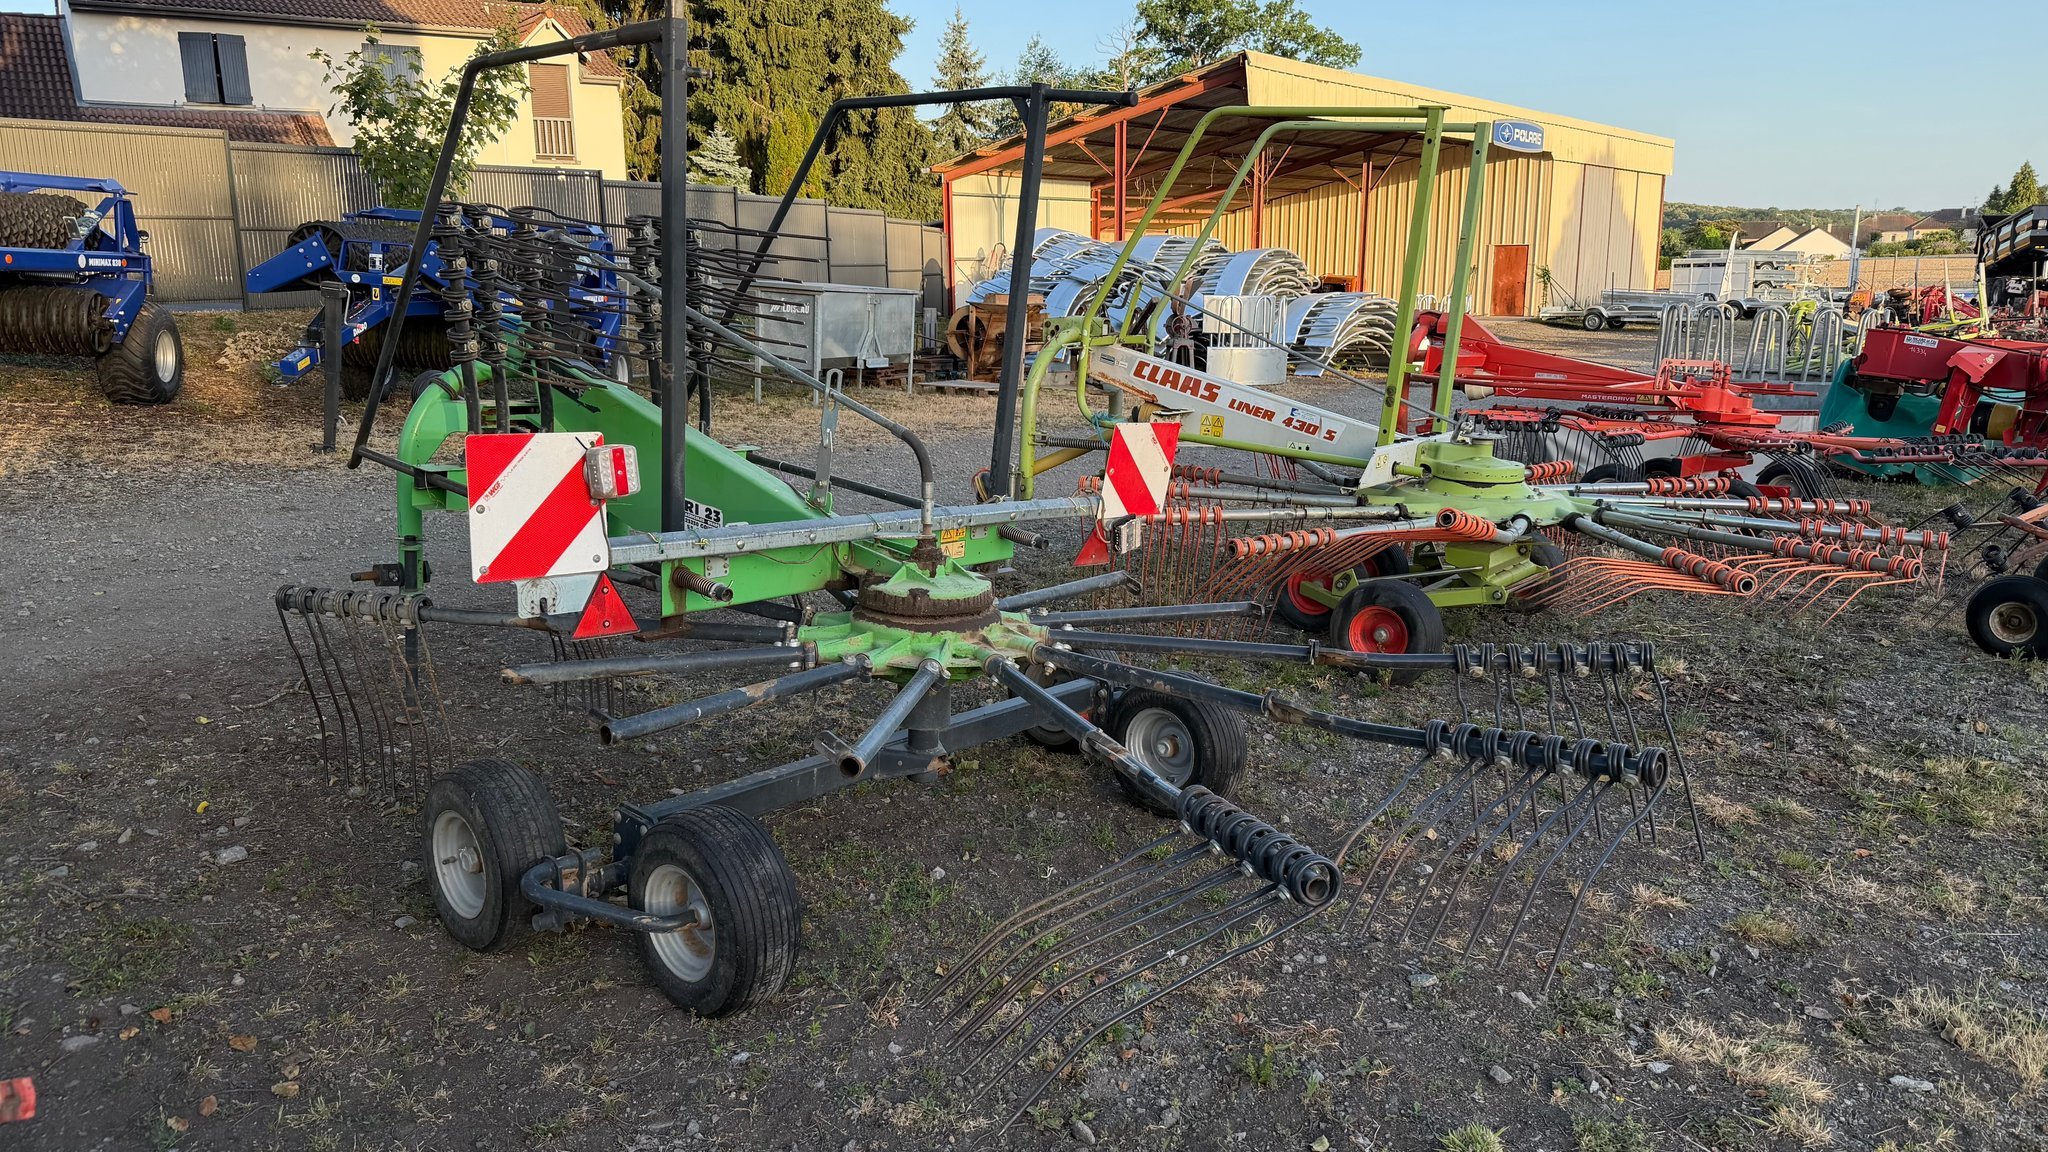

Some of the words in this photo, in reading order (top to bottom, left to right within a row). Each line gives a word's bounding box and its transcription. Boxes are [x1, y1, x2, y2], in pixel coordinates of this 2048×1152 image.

[1514, 128, 1542, 145] POLARIS
[1133, 360, 1221, 402] CLAAS
[1227, 398, 1276, 422] LINER
[1281, 416, 1319, 437] 430
[1322, 428, 1337, 442] S
[1581, 394, 1636, 402] MASTERDRIVE
[704, 507, 720, 522] 23
